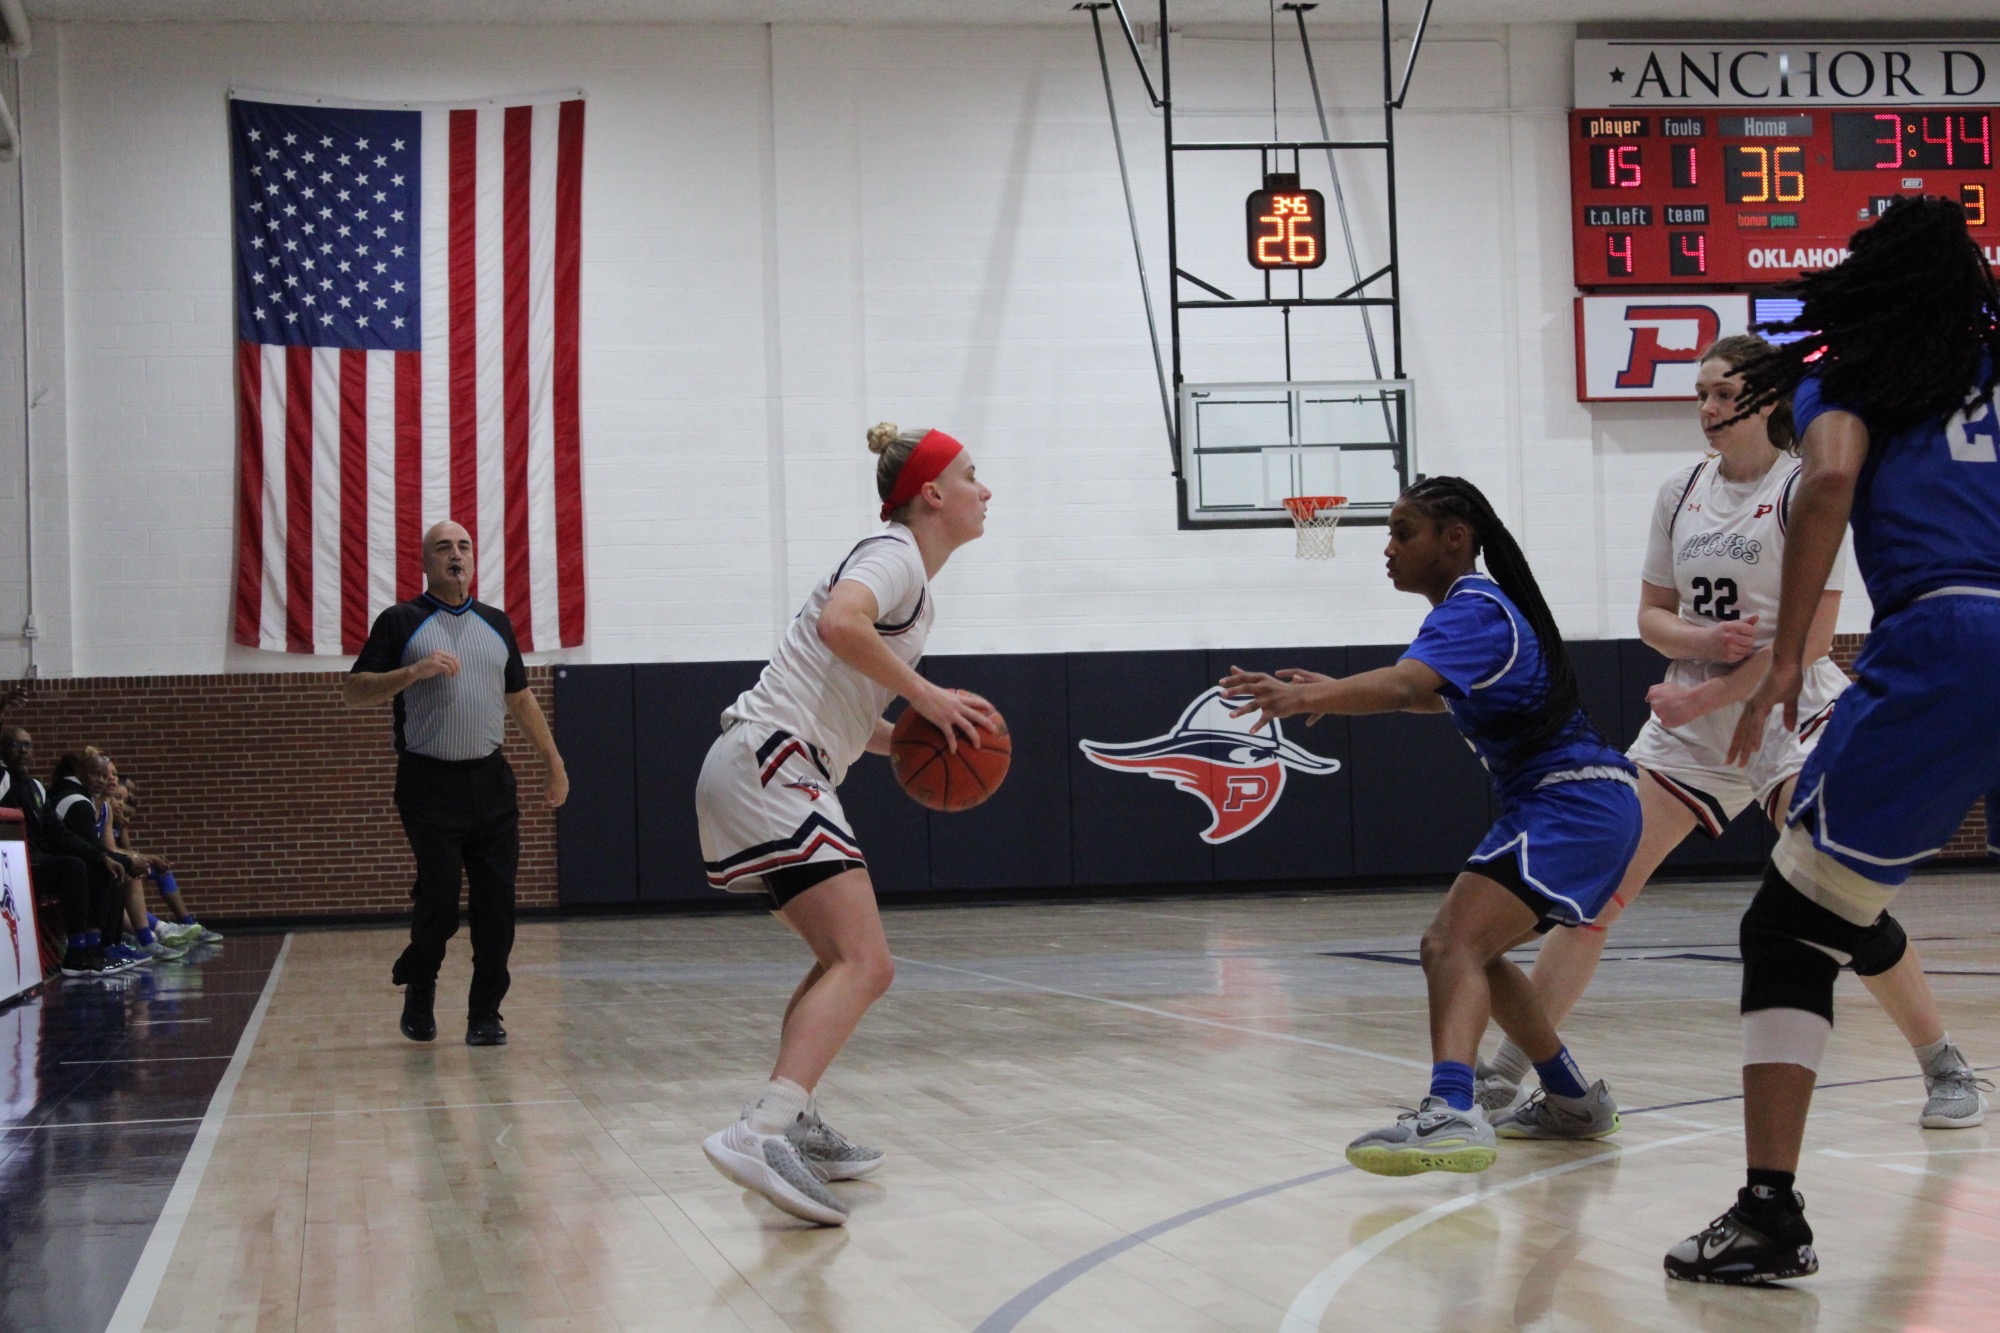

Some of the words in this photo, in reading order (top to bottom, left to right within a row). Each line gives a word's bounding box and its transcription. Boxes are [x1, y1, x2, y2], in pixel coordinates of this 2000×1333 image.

[1631, 51, 1924, 98] ANCHOR
[1590, 117, 1641, 138] player
[1664, 118, 1701, 136] fouls
[1744, 116, 1787, 137] Home
[1874, 113, 1989, 170] 3:44
[1608, 145, 1641, 187] 15
[1689, 147, 1697, 184] 1
[1740, 146, 1805, 202] 36
[1668, 207, 1705, 223] team
[1738, 213, 1768, 227] bonus
[1963, 184, 1985, 225] 3
[1258, 216, 1316, 262] 26
[1608, 235, 1633, 273] 4
[1681, 235, 1706, 272] 4
[1945, 385, 2000, 462] 2
[1677, 532, 1762, 565] AGGIES
[1692, 576, 1741, 621] 22
